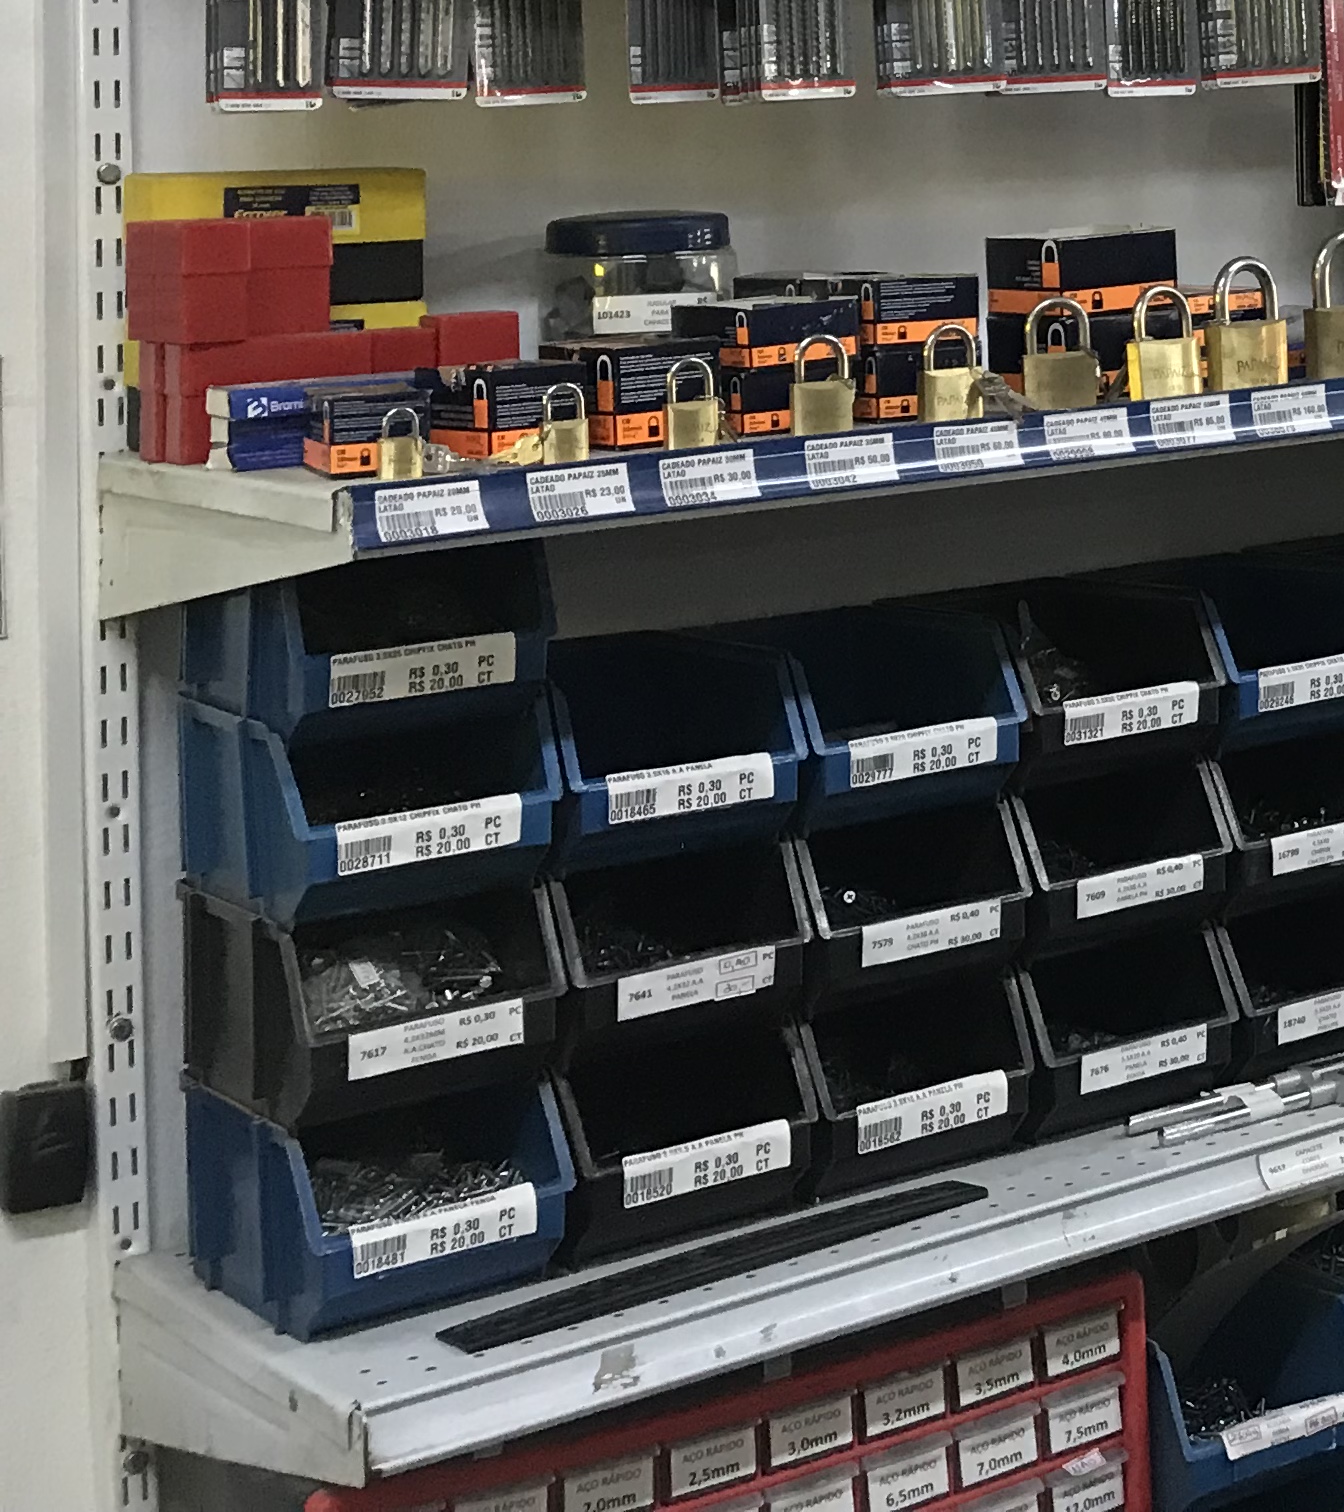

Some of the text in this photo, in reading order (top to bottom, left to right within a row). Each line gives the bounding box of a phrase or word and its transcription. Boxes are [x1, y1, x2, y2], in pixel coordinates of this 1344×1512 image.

[698, 456, 723, 466] PAPAIZ
[530, 474, 565, 486] CADEADO
[567, 471, 595, 481] PAPAIZ
[662, 469, 686, 479] LATAO
[713, 474, 725, 483] R$
[530, 484, 555, 494] LATAO
[585, 488, 597, 498] R$
[536, 506, 589, 521] 0003026
[409, 667, 425, 679] R$
[478, 655, 494, 667] PC
[477, 671, 493, 684] CT
[678, 785, 692, 797] R$
[739, 772, 754, 784] PC
[678, 798, 692, 810] R$
[739, 788, 754, 799] CT
[416, 832, 431, 844] R$
[484, 816, 501, 828] PC
[416, 845, 431, 857] R$
[484, 833, 500, 846] CT
[339, 853, 391, 872] 0028711
[1061, 1344, 1106, 1365] 4,0mm
[975, 1371, 1020, 1395] 3,5mm
[883, 1402, 930, 1426] 3,2mm
[1065, 1419, 1109, 1443] 7,5mm
[787, 1431, 838, 1456] 3,0mm
[689, 1461, 740, 1486] 2,5mm
[976, 1450, 1023, 1475] 7,0mm
[886, 1481, 935, 1507] 6,5mm
